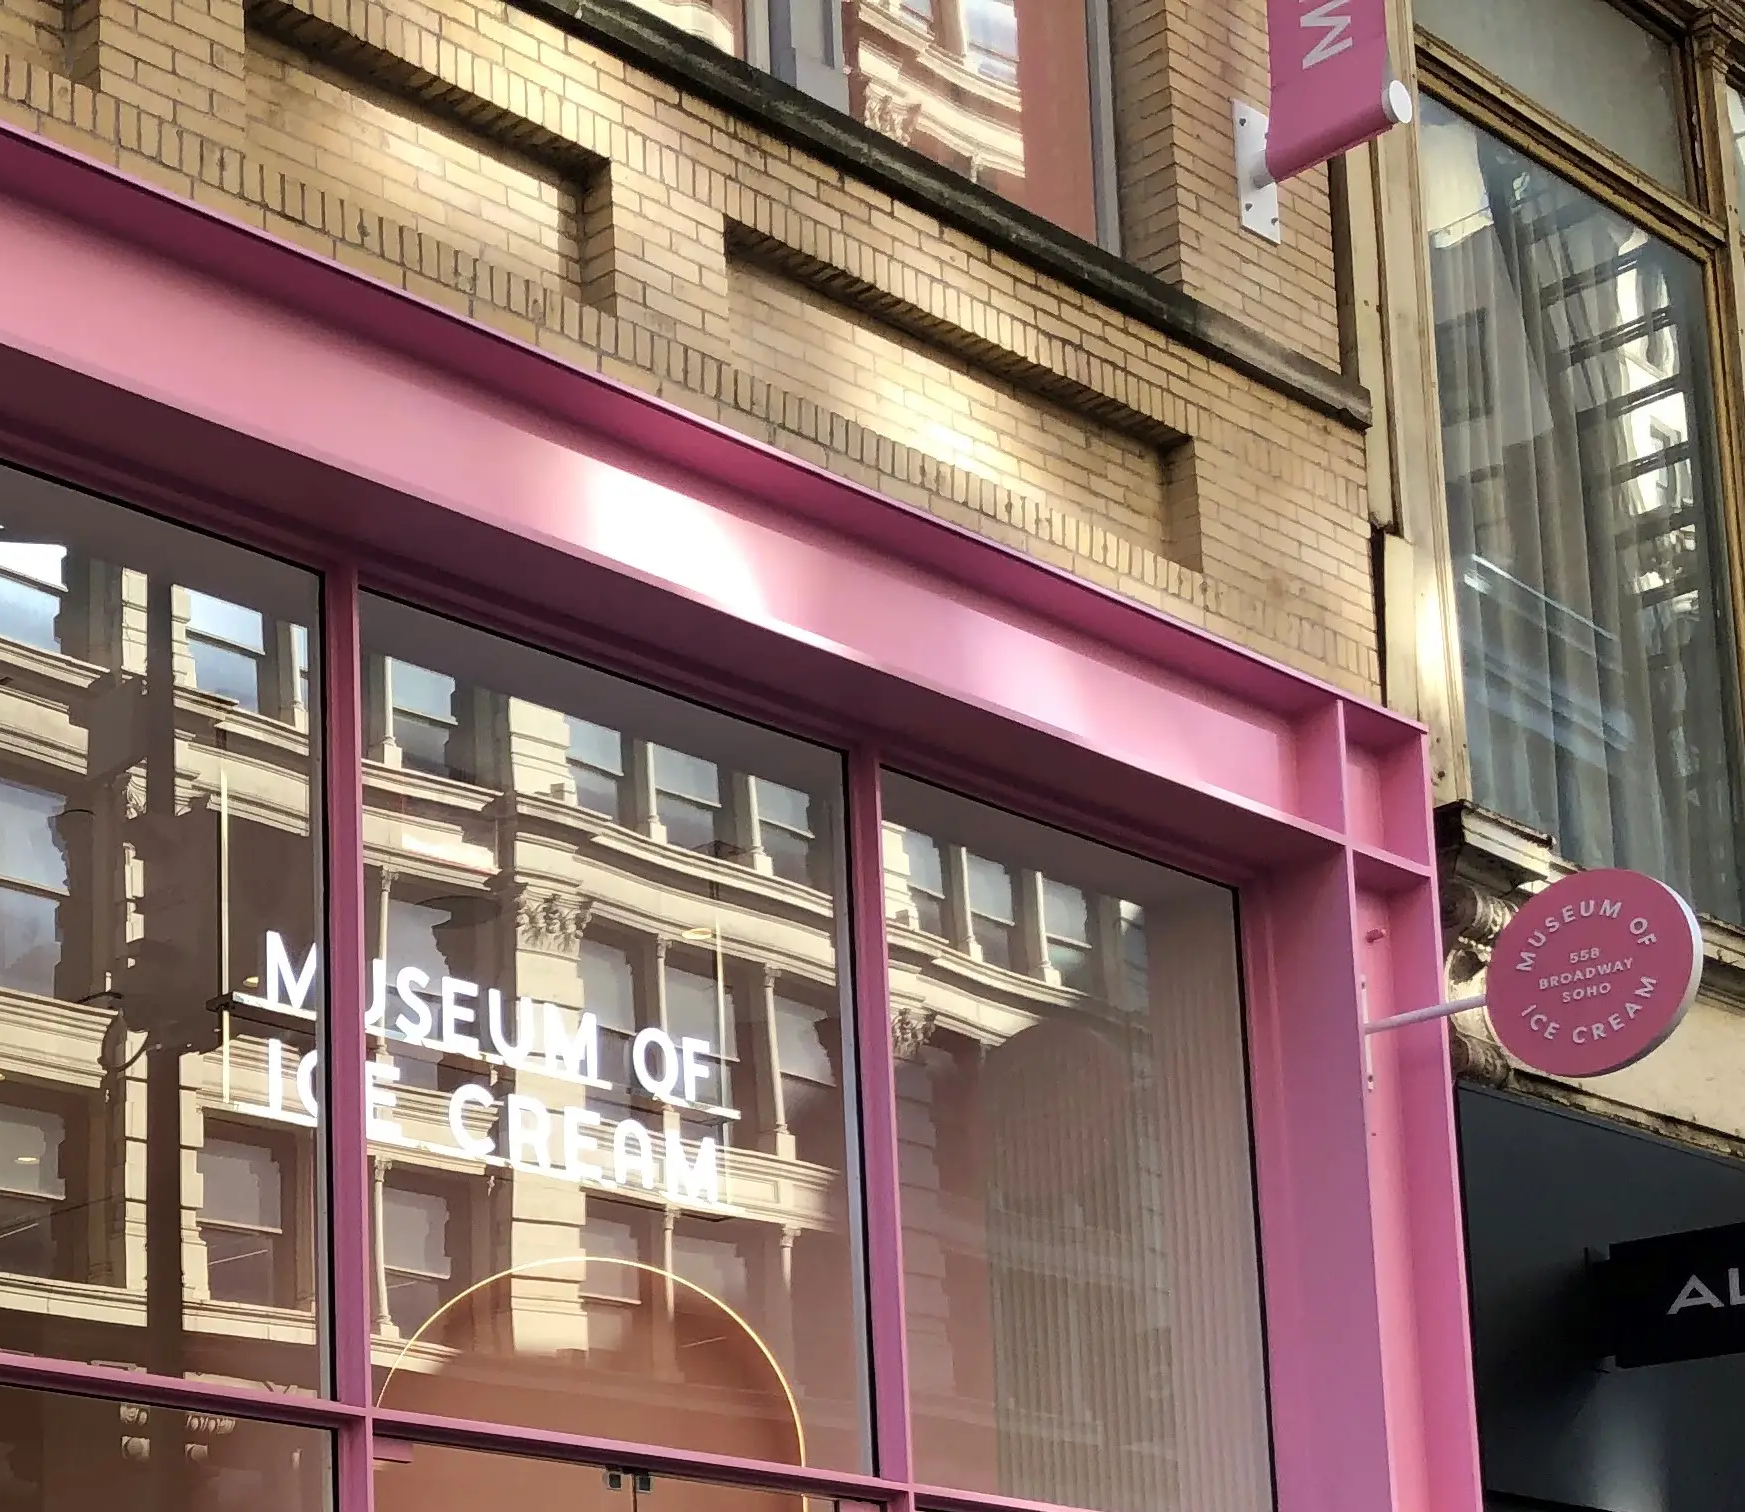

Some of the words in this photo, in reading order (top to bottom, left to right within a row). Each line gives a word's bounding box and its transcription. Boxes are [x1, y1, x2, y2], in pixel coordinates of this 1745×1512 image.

[1516, 899, 1623, 972] MUSEUM
[1629, 917, 1657, 946] OF
[1569, 947, 1600, 964] 558
[1539, 957, 1633, 990] BROADWAY
[1562, 983, 1612, 1003] SOHO
[1521, 1004, 1560, 1040] ICE
[1572, 976, 1657, 1044] CREAM
[632, 1027, 711, 1102] OF
[448, 1084, 718, 1203] CREAM
